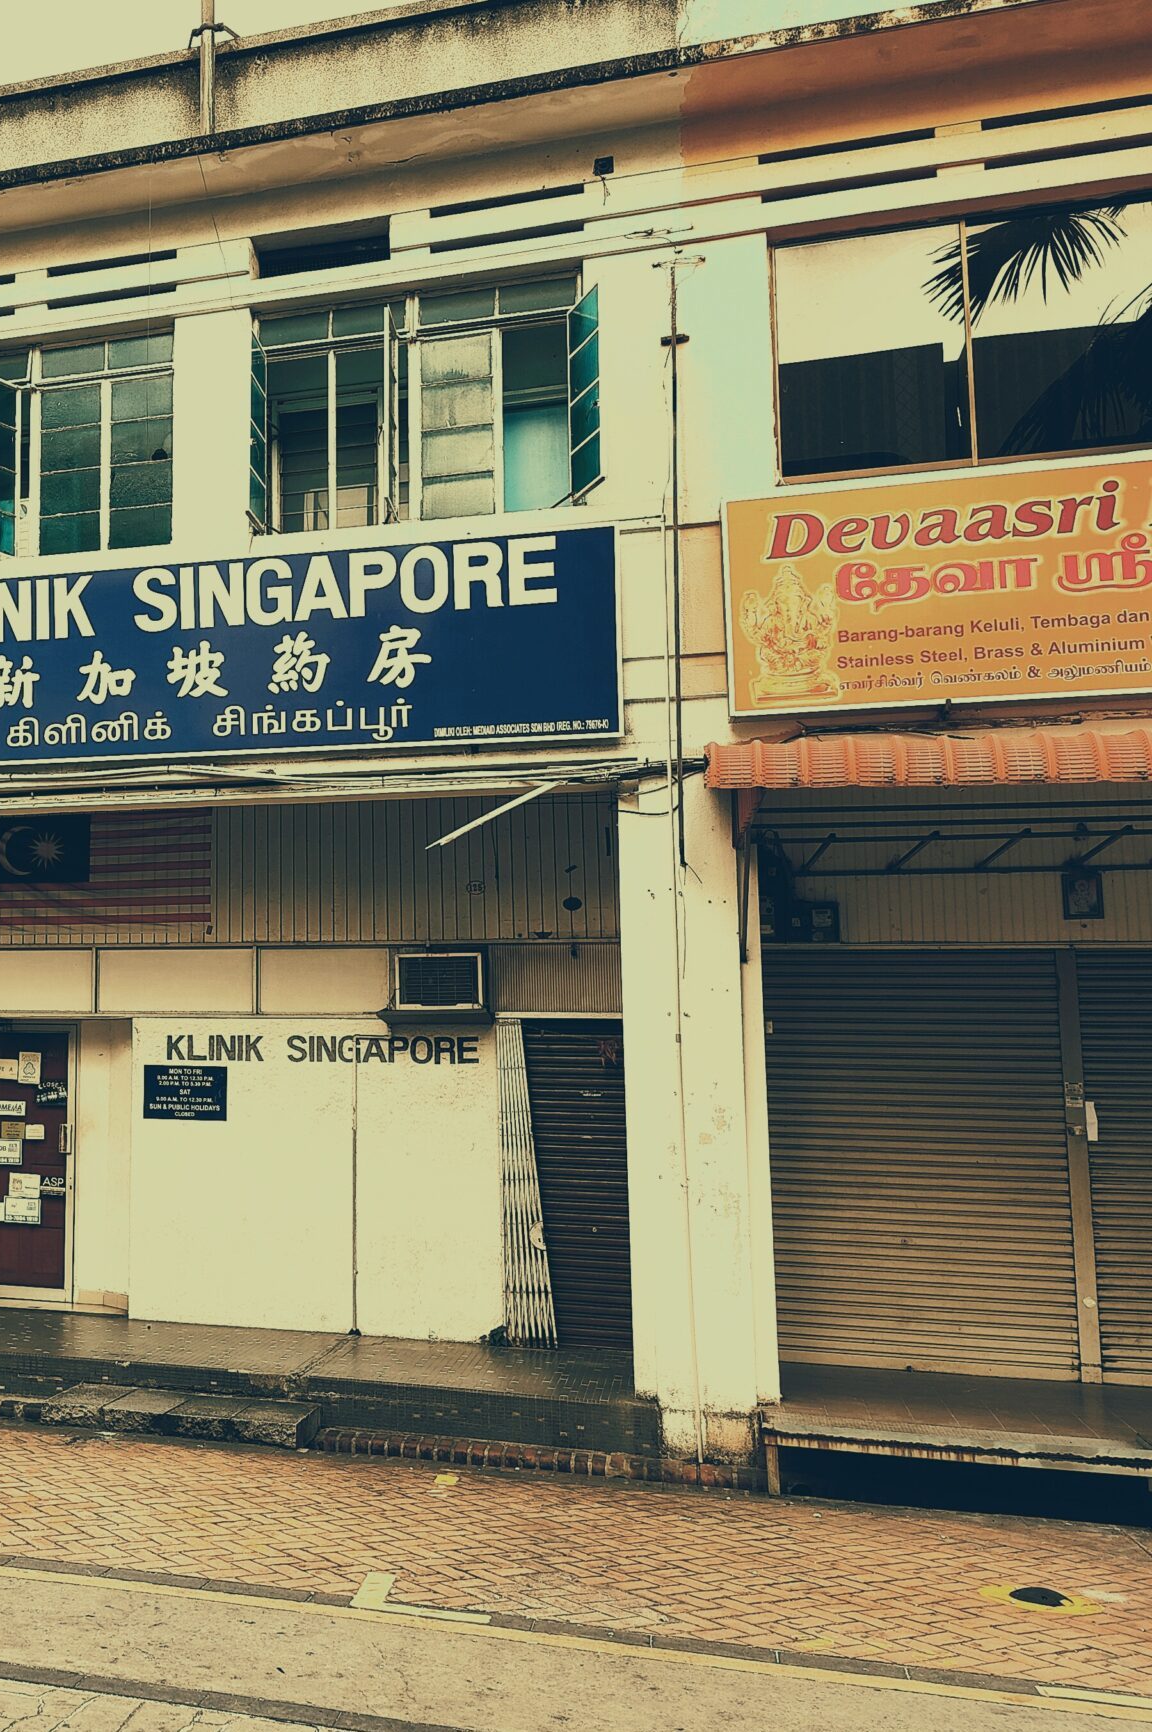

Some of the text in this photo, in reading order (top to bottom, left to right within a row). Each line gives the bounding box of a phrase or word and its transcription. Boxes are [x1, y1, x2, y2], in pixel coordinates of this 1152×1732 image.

[765, 480, 1120, 560] Devaasri
[132, 535, 558, 633] SINGAPORE
[835, 556, 1038, 612] தேவா
[837, 609, 1150, 643] Barang-barang Keluli, Tembaga dan
[836, 637, 1145, 670] Stainless Steel, Brass & Aluminium
[1027, 665, 1041, 679] &
[6, 697, 414, 747] கிளினிக் சிங்கப்பூர்
[495, 722, 530, 735] ASSOCIATES
[530, 722, 542, 733] SDN
[542, 721, 556, 733] BHD
[166, 1034, 480, 1065] KLINIK SINGAPORE
[42, 1177, 64, 1187] ASP
